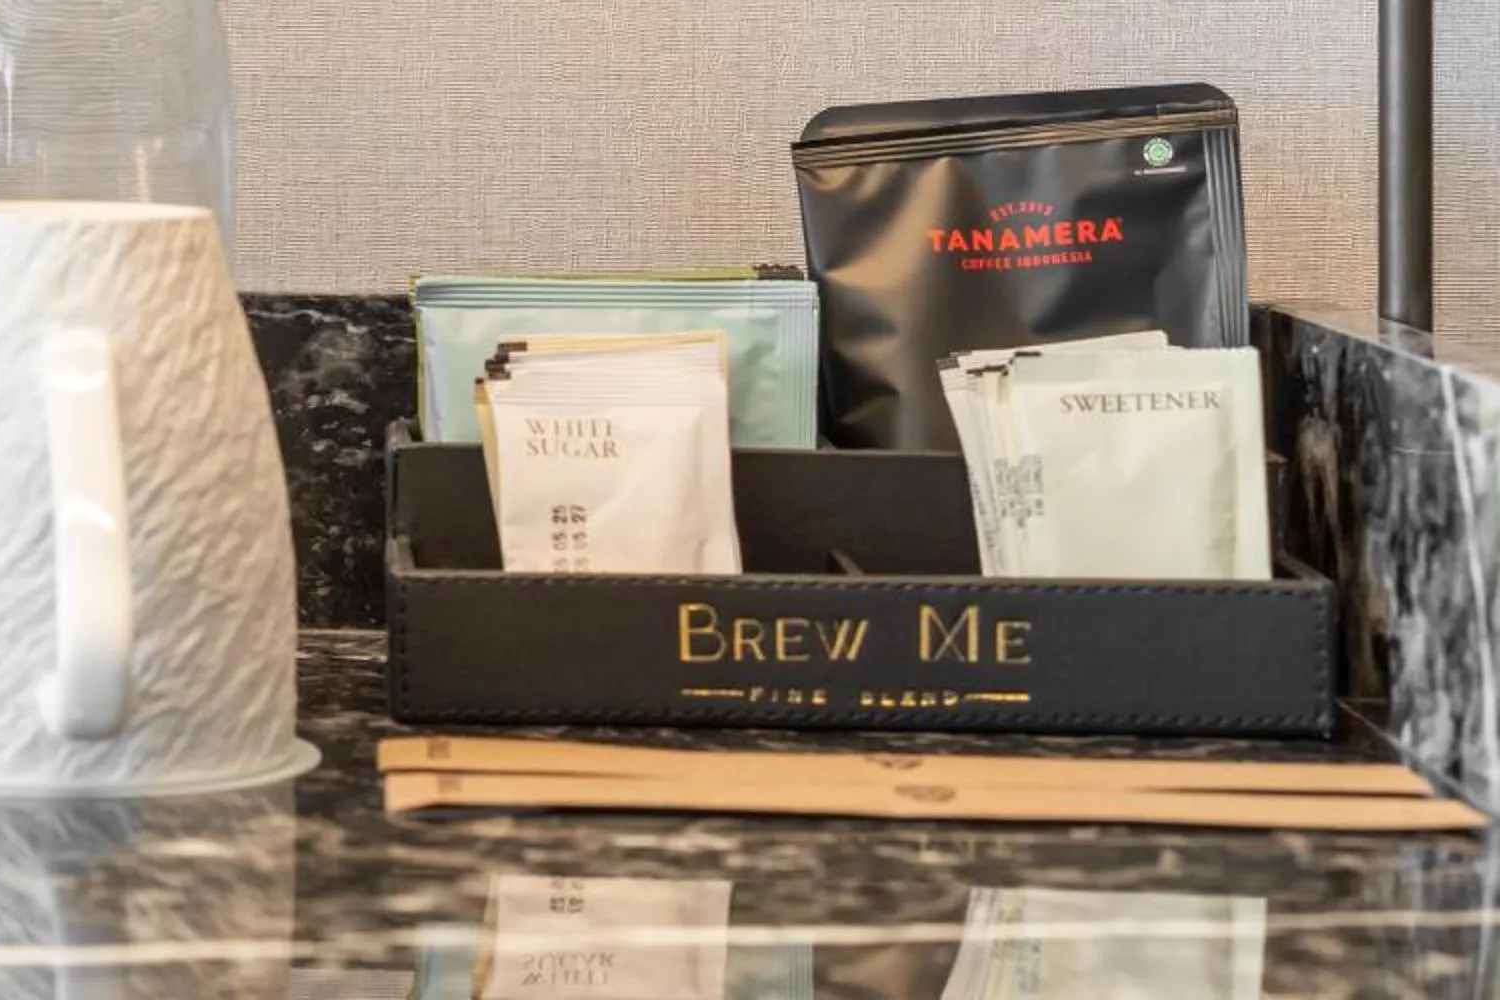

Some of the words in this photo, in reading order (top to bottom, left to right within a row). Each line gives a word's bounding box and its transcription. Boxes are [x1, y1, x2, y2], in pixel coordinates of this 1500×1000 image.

[927, 217, 1124, 252] TANAMERA
[962, 257, 1011, 271] COFFEE
[1016, 251, 1093, 269] INDONESIA
[1059, 391, 1221, 414] SWEETENER
[526, 437, 619, 458] SUGAR
